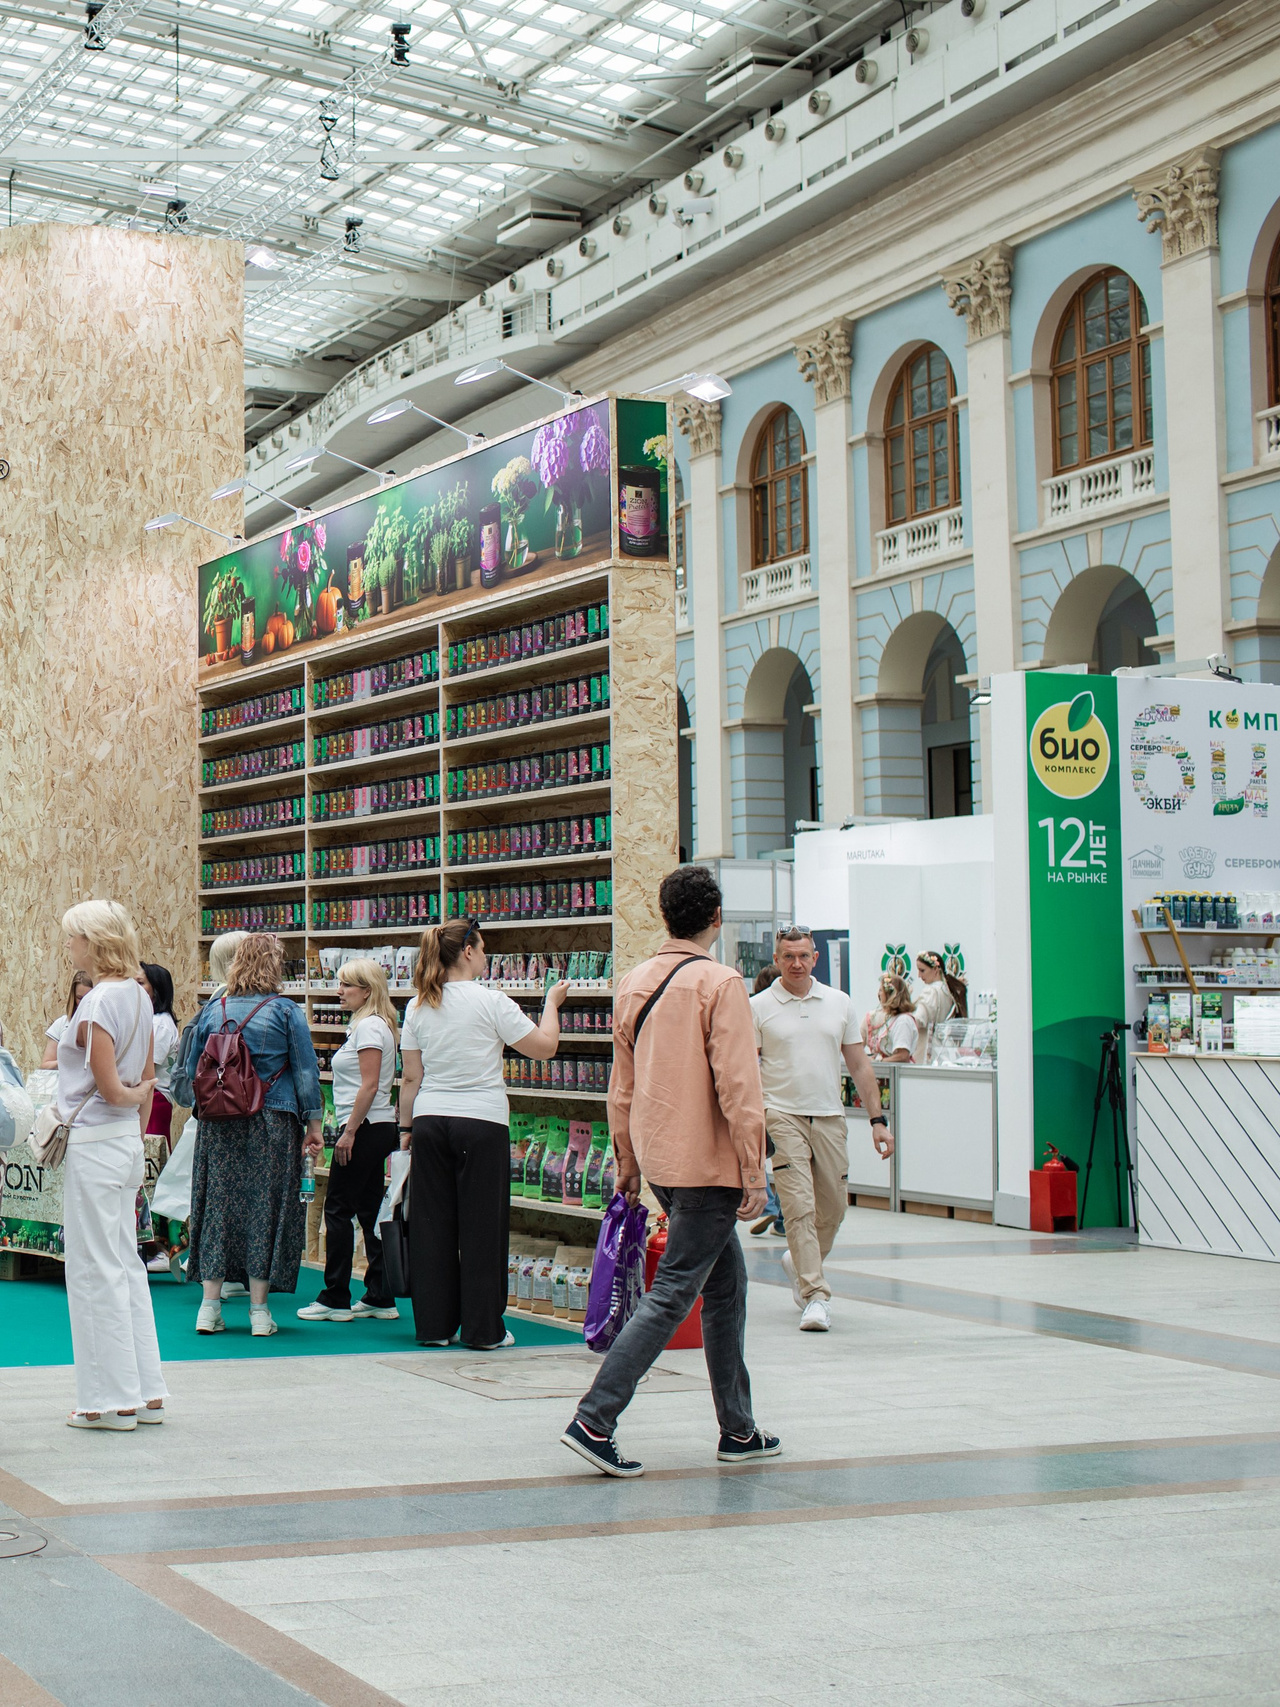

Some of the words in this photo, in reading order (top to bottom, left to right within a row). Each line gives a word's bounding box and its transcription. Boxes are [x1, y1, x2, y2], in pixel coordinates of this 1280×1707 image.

[1040, 728, 1100, 761] био
[1045, 765, 1096, 774] КОМПЛЕКС
[1146, 798, 1182, 811] ЭКБИ
[1038, 817, 1087, 867] 12
[1089, 820, 1107, 868] ЛЕТ
[1179, 846, 1217, 862] ЦВЕТЫ
[1132, 860, 1161, 869] ДАЧНЫЙ
[1185, 861, 1213, 878] БУМ
[1047, 872, 1064, 883] НА
[1067, 872, 1107, 884] РЫНКЕ
[1133, 869, 1161, 877] ПОМОЩНИК
[5, 1162, 45, 1193] ON
